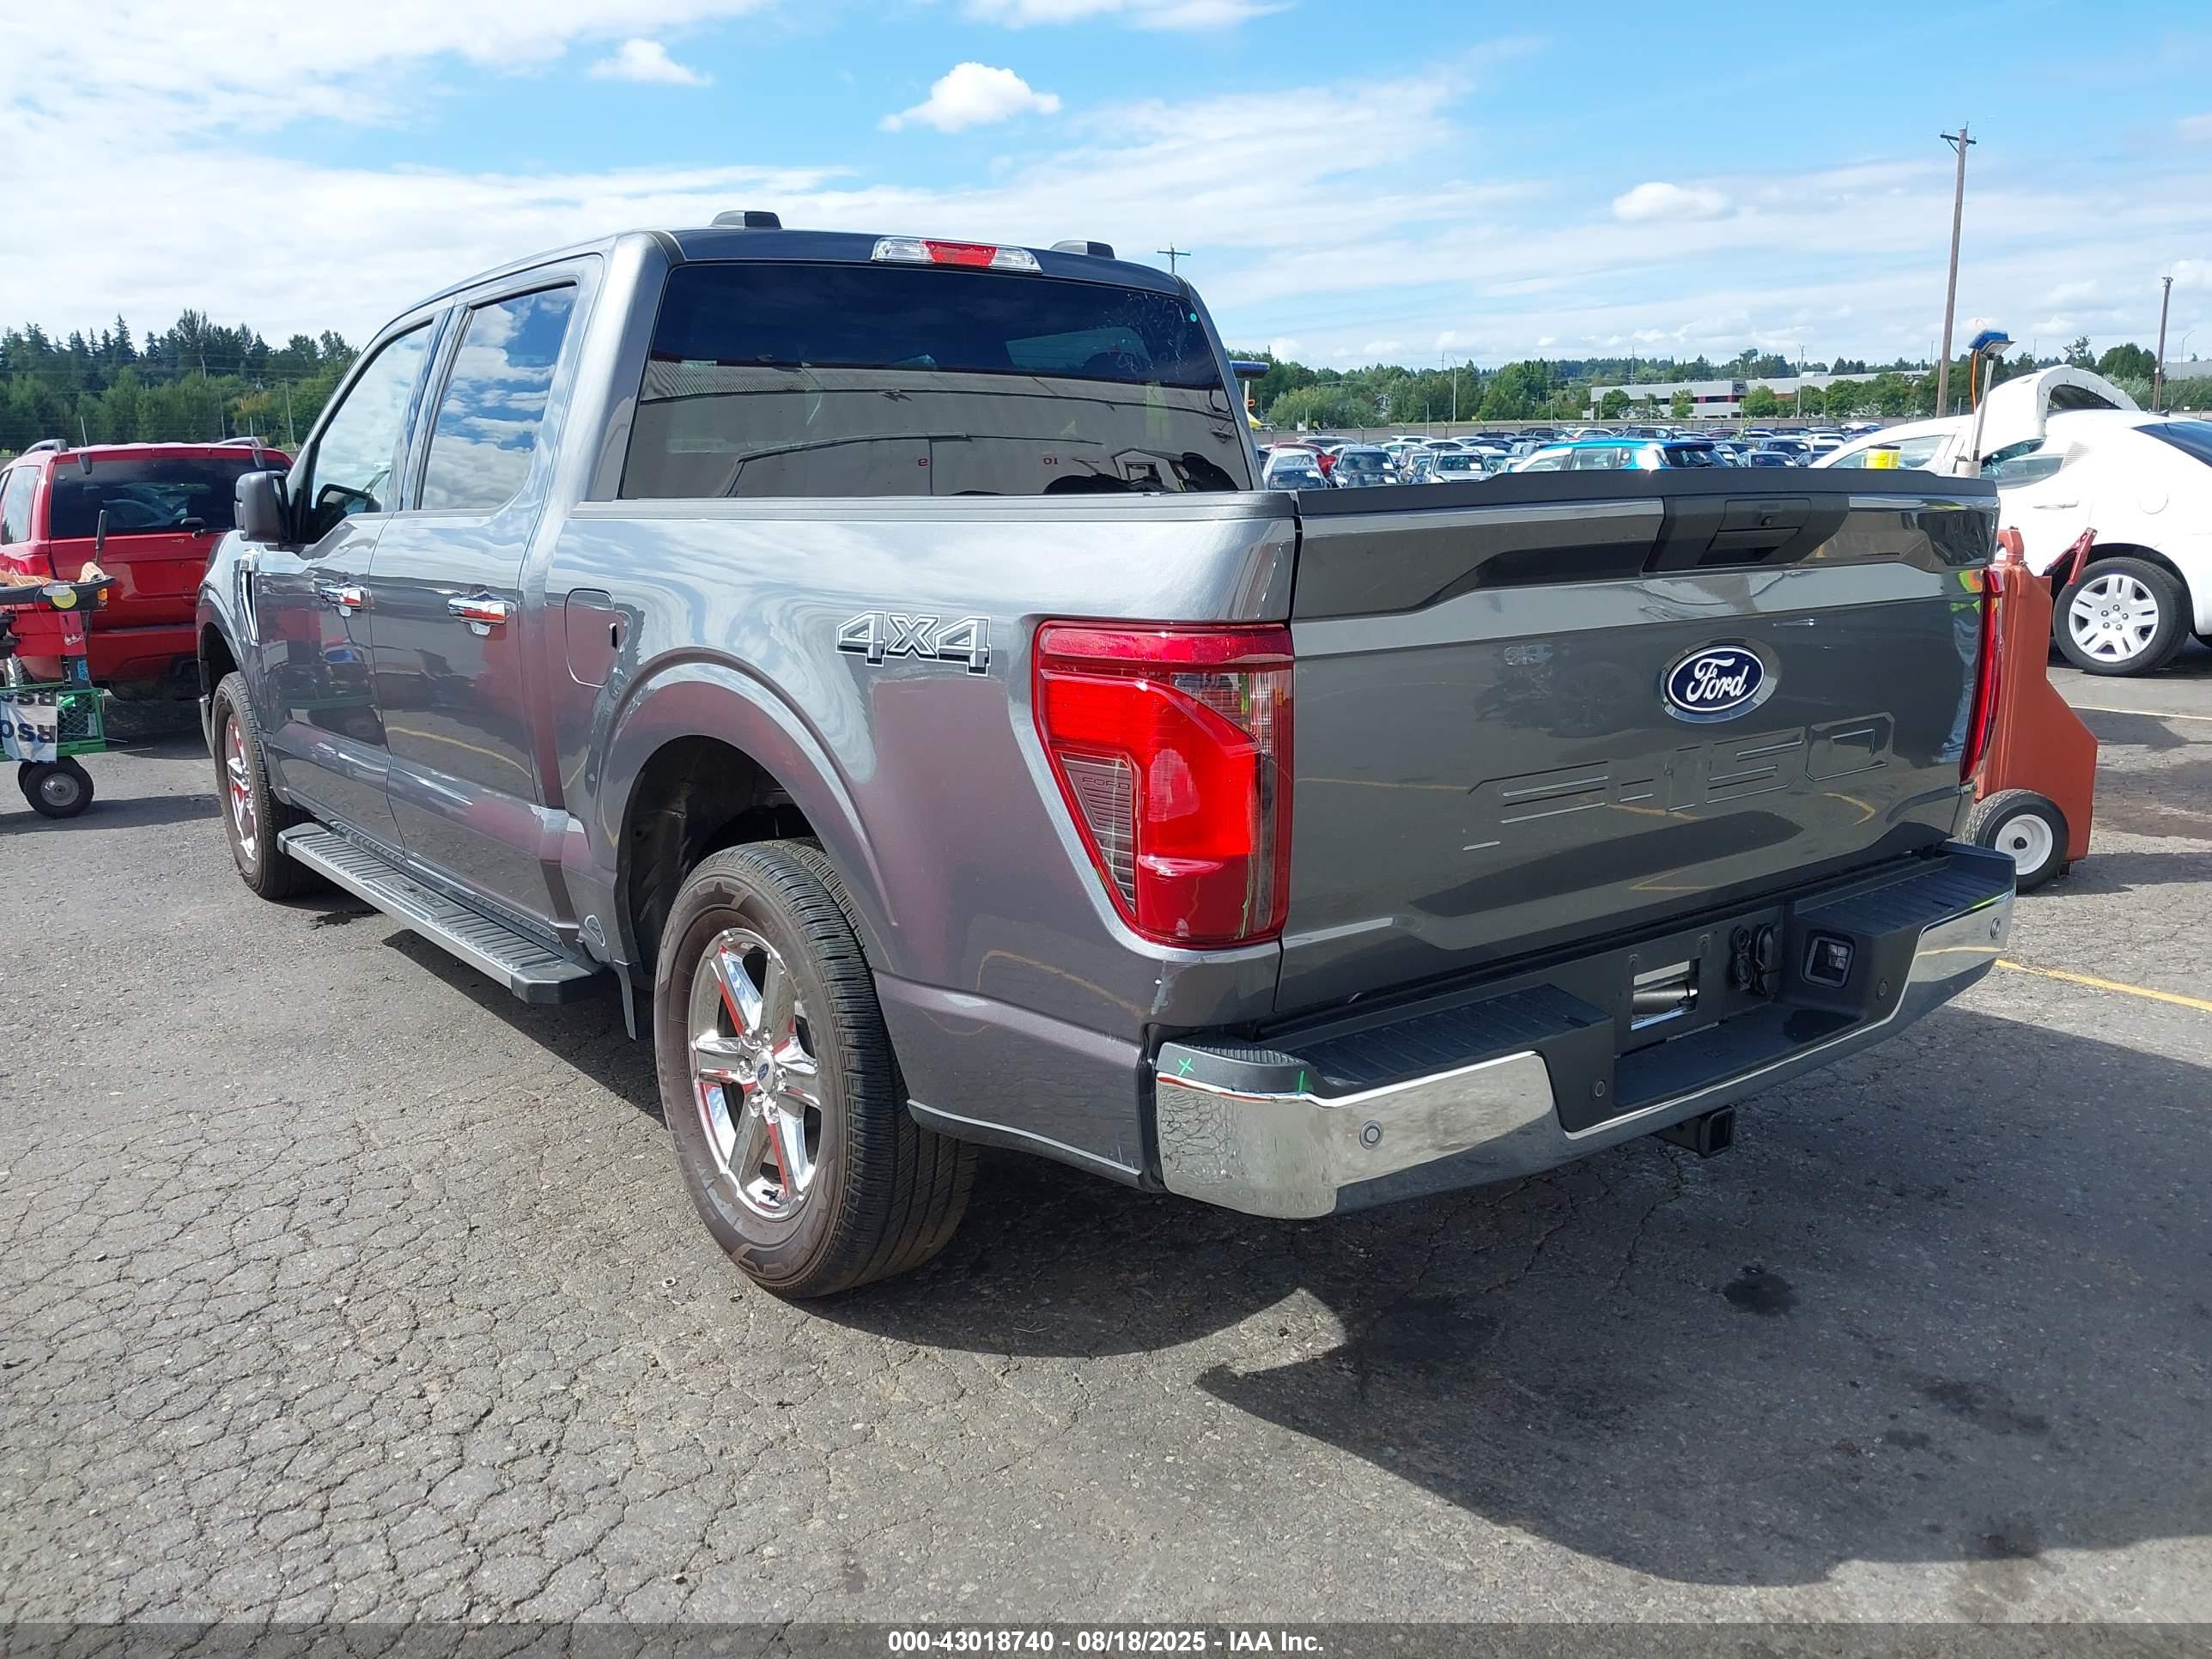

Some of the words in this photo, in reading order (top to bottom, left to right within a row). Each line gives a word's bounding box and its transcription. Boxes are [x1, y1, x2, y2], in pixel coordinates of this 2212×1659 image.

[1686, 658, 1750, 702] Ford
[1082, 776, 1130, 790] FORD
[1462, 713, 1895, 852] F-150
